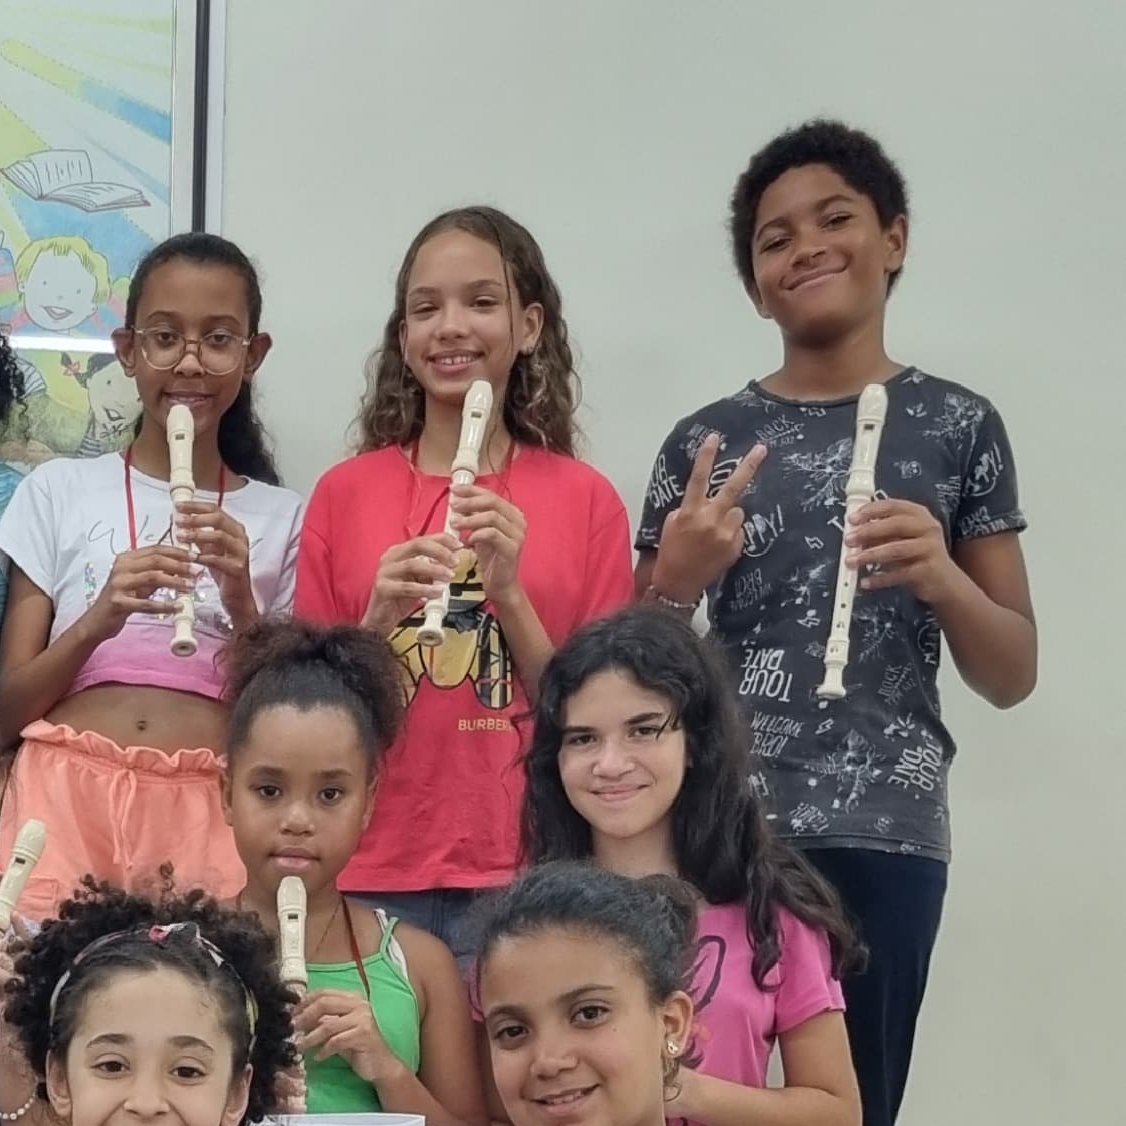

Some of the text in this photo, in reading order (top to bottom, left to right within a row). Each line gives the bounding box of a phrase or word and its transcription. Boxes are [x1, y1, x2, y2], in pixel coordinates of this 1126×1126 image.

[649, 475, 685, 509] DATE
[743, 504, 785, 546] PPY!
[740, 648, 785, 670] DATE
[739, 668, 793, 702] TOUR
[751, 711, 805, 738] WELCOME
